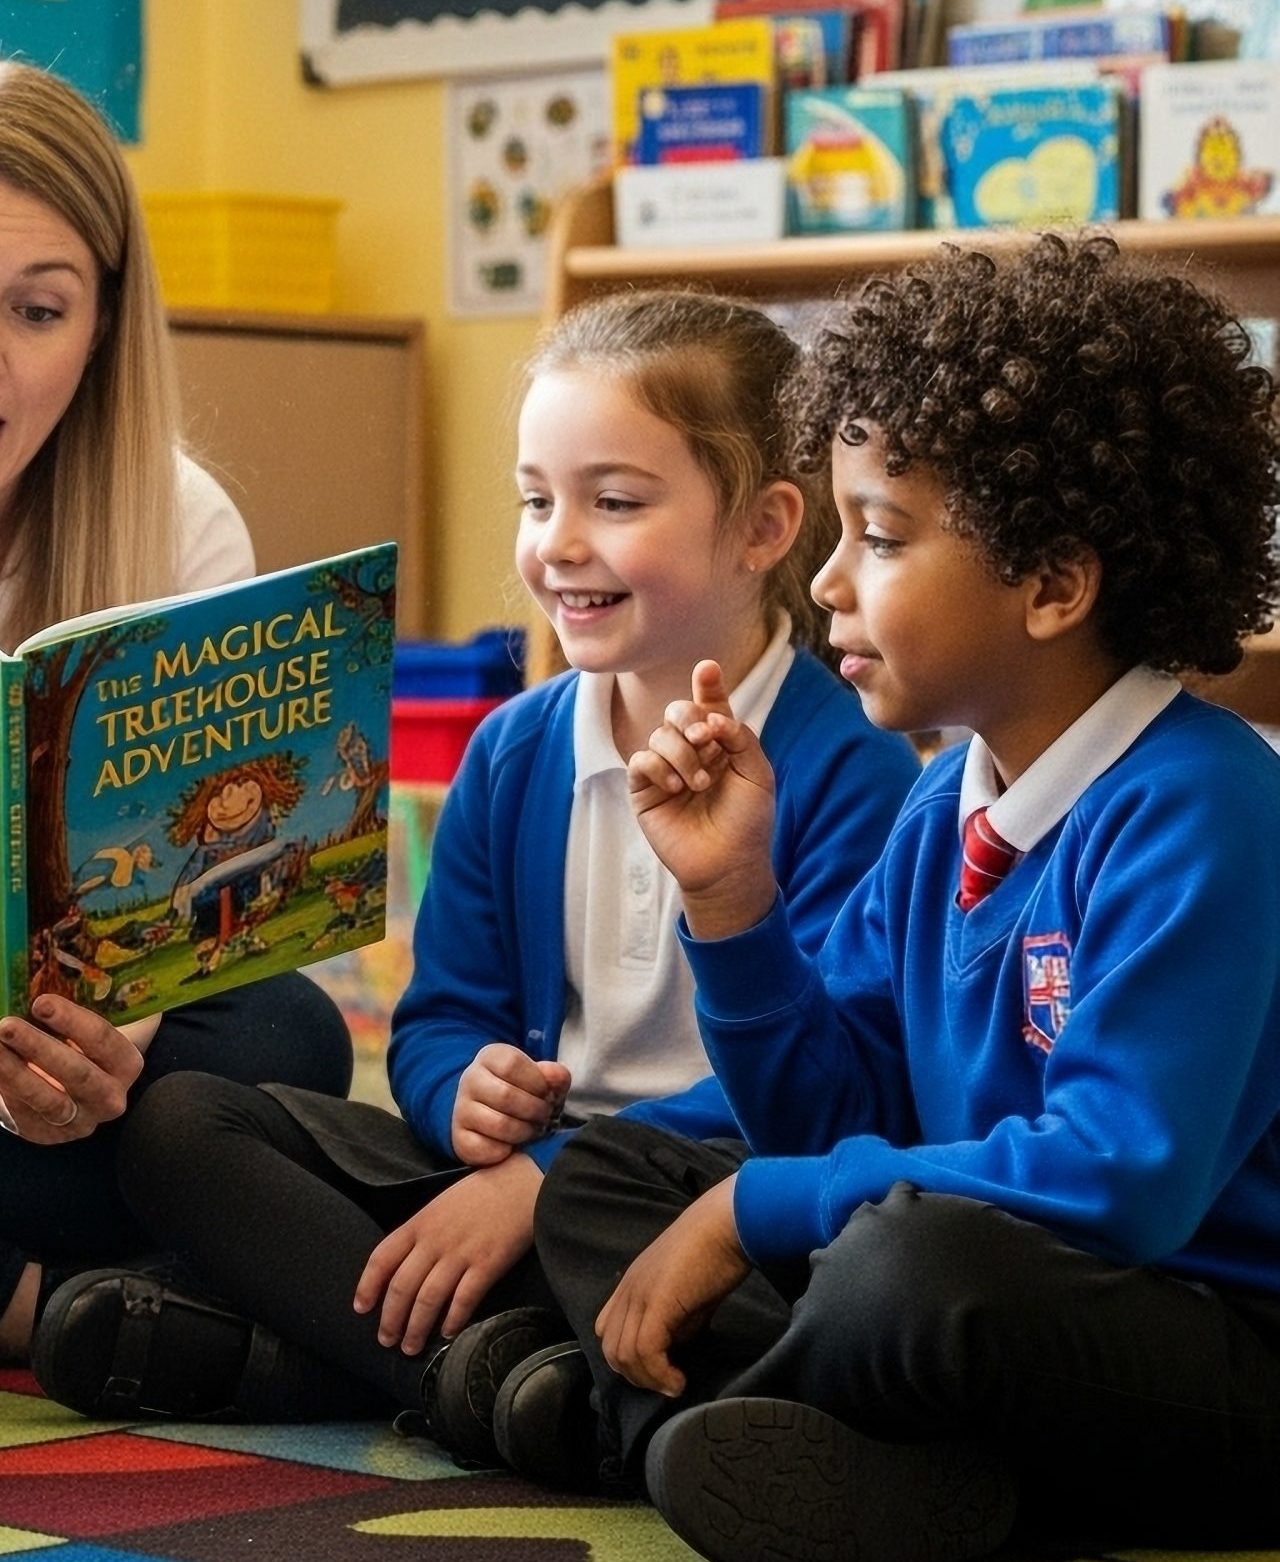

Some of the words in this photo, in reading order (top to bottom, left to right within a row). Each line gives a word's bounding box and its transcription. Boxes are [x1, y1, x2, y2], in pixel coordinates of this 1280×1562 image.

[152, 602, 346, 687] MAGICAL
[93, 689, 333, 798] ADVENTURE
[96, 650, 330, 747] TREEHOUSE
